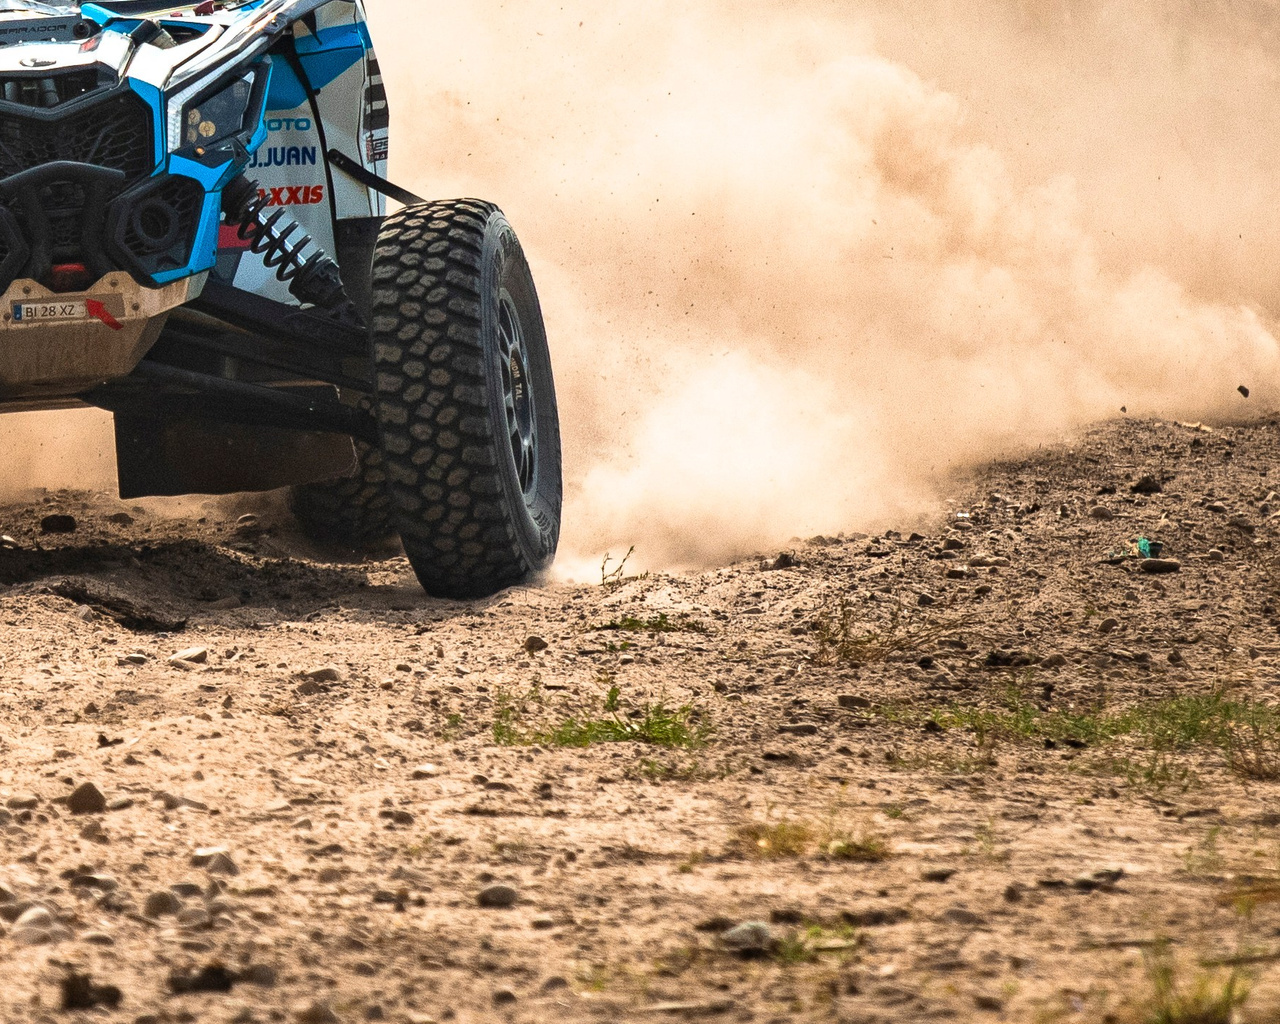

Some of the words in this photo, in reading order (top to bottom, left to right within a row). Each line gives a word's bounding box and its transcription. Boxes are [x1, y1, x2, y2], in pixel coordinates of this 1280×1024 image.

[257, 184, 324, 207] AXXIS
[41, 306, 56, 317] 28
[59, 305, 75, 316] XZ
